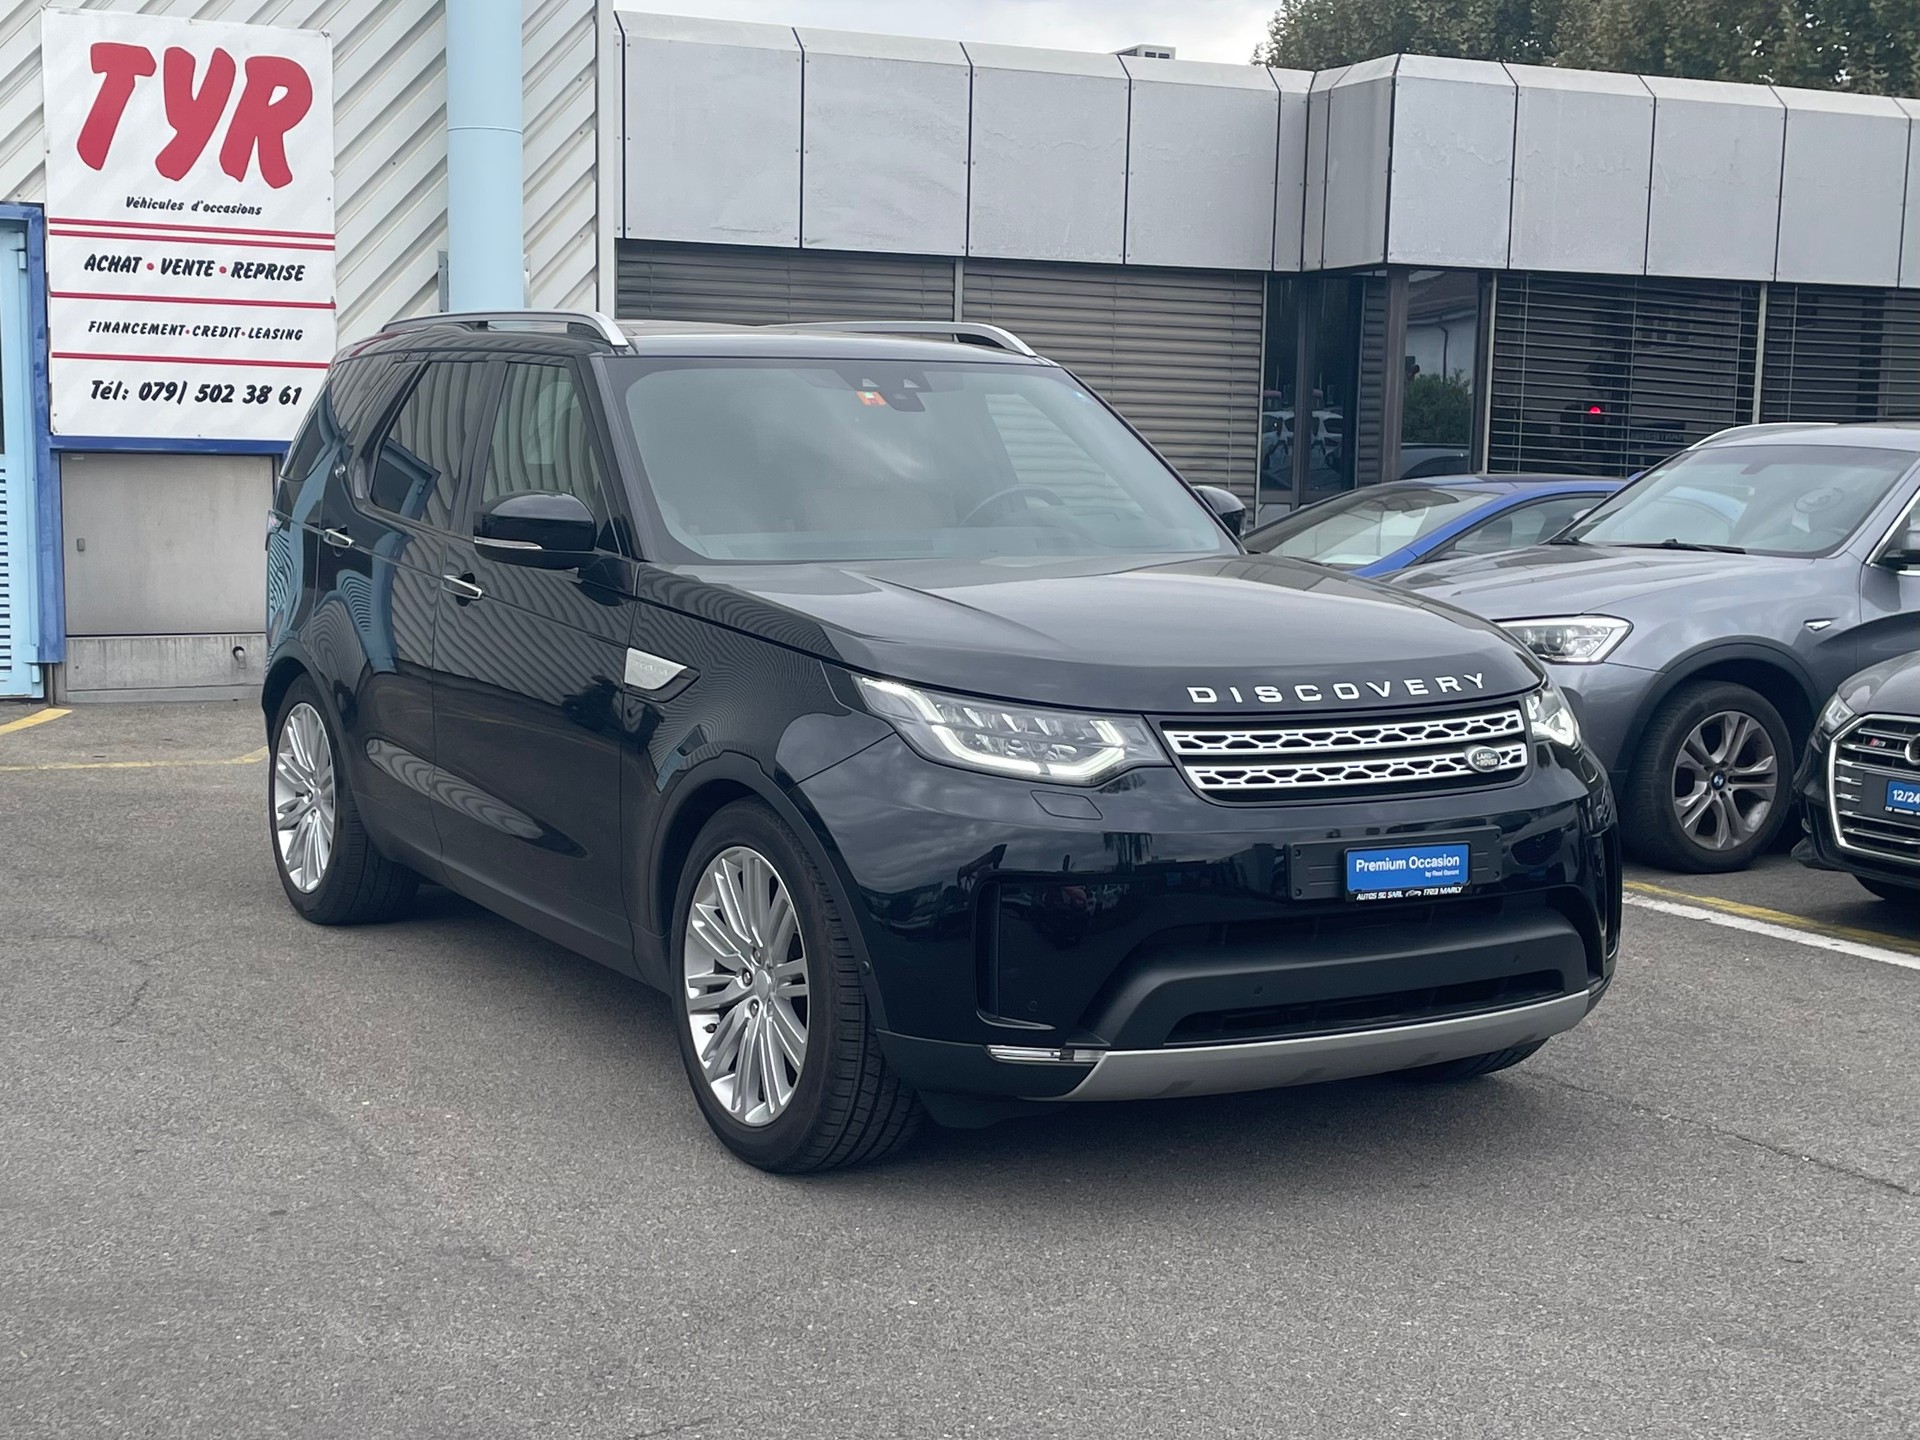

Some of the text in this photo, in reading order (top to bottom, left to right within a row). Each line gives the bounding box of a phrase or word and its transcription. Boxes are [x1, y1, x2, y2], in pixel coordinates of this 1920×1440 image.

[77, 42, 313, 189] TYR
[126, 196, 262, 215] Véhicules d'occasions
[84, 254, 305, 281] ACHAT VENTE REPRISE
[88, 321, 303, 340] FINANCEMENT CREDIT LEASING
[91, 380, 129, 400] Tél:
[195, 384, 235, 403] 502
[243, 386, 272, 403] 38
[279, 386, 302, 405] 61
[1187, 673, 1483, 703] DISCOVERY
[1356, 854, 1460, 872] Premium Occasion
